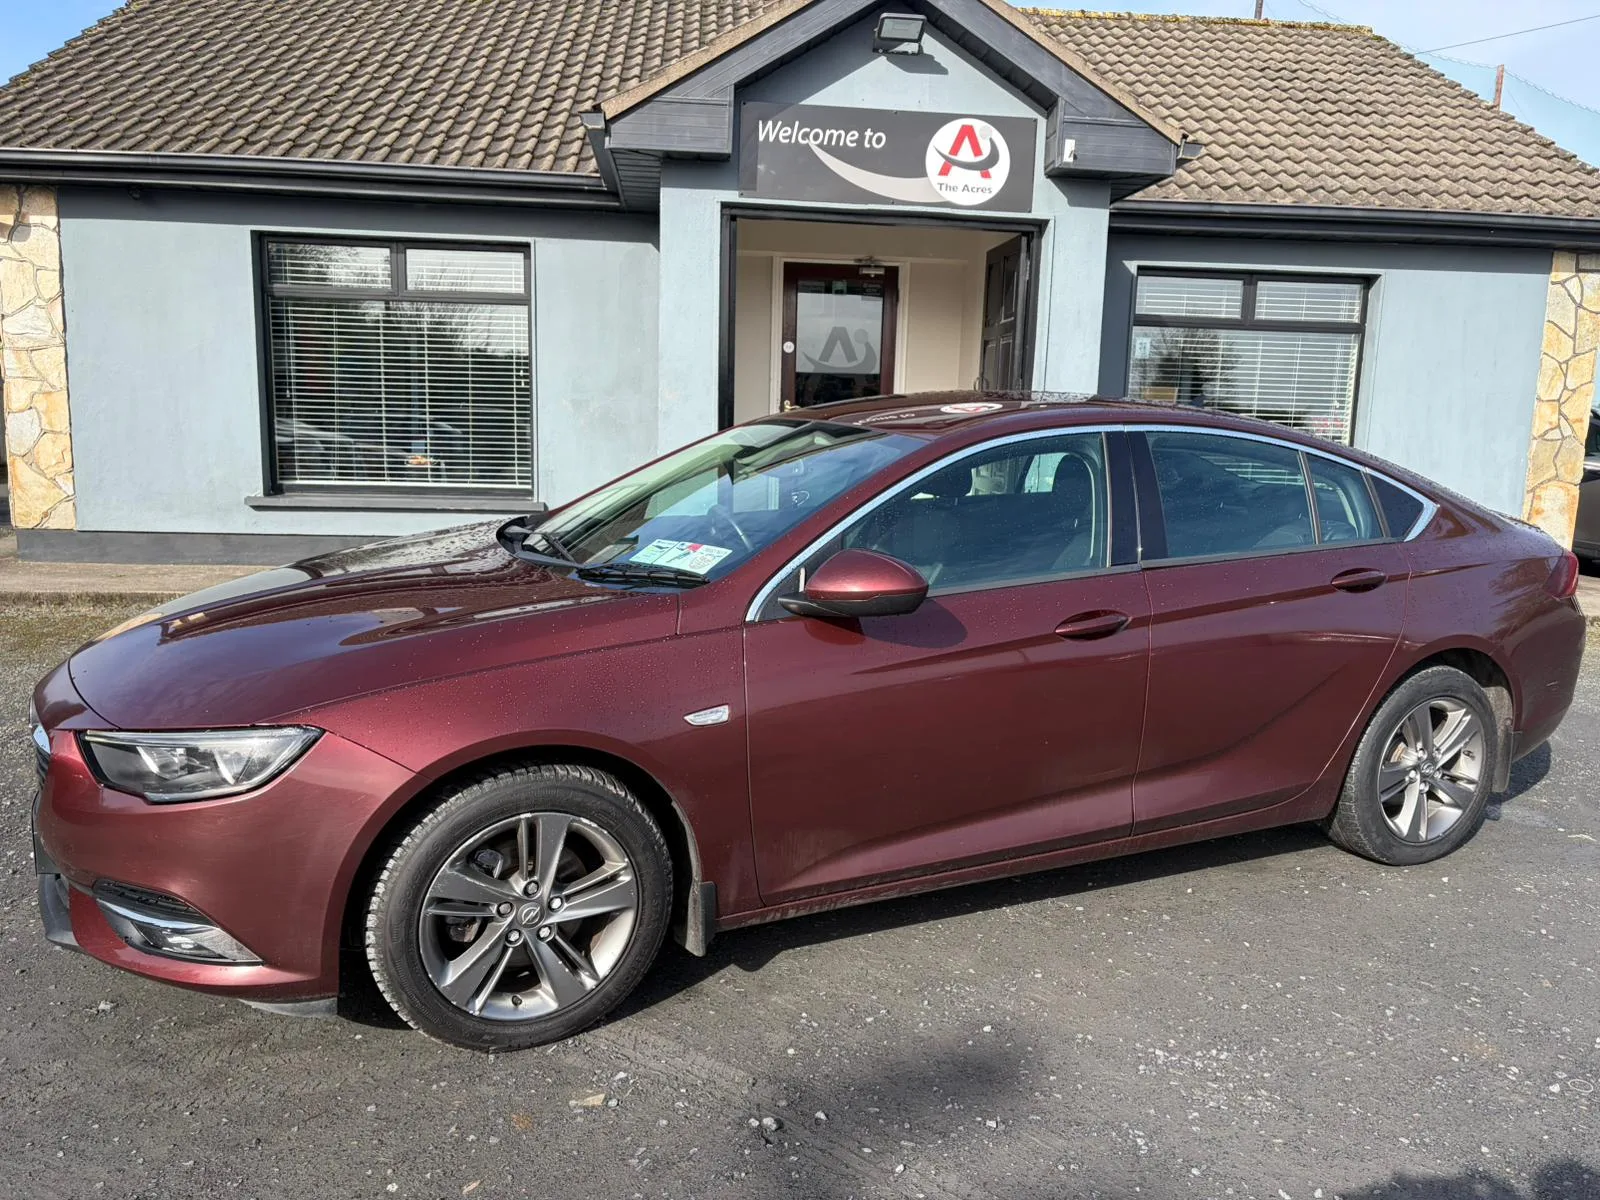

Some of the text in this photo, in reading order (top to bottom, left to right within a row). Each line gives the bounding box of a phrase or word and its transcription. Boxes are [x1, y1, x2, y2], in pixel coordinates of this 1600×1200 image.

[758, 119, 887, 149] Welcome to
[937, 182, 993, 194] The Acres
